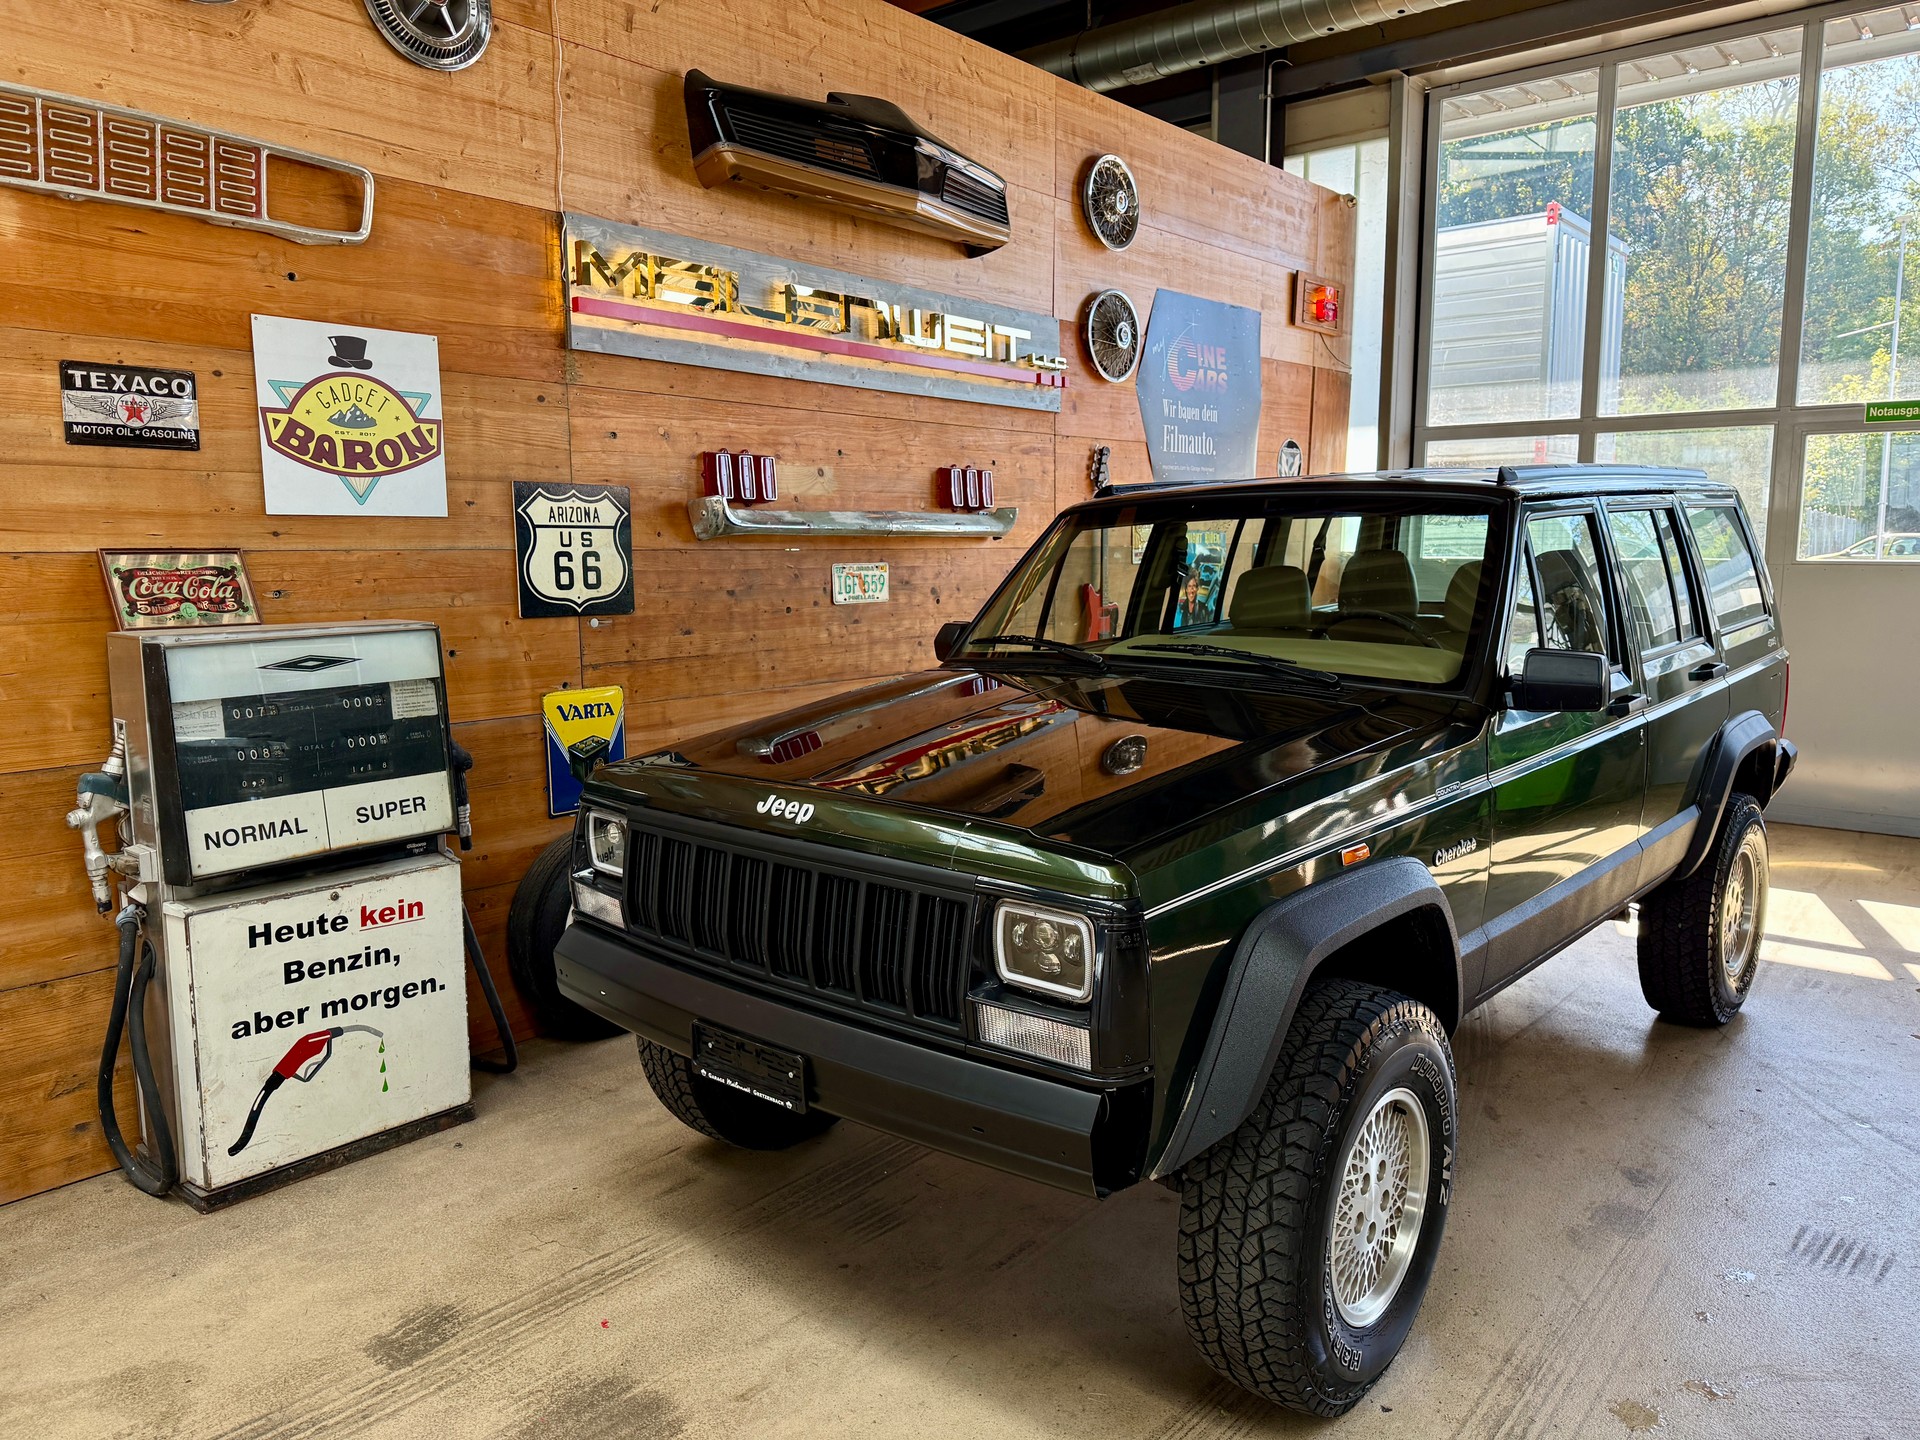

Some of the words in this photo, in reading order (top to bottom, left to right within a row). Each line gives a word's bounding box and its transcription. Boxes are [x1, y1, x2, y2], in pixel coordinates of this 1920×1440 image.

[67, 369, 190, 396] TEXACO
[315, 382, 390, 413] GADGET
[1162, 398, 1177, 418] Wir
[1178, 400, 1200, 423] bauen
[1201, 403, 1218, 424] dein
[1869, 406, 1920, 418] Notausga
[72, 424, 114, 436] MOTOR
[116, 426, 134, 437] OIL
[141, 428, 196, 441] GASOLINE
[274, 416, 436, 471] BARON
[1162, 424, 1217, 456] Filmauto.
[548, 506, 601, 523] ARIZONA
[553, 550, 602, 591] 66
[128, 575, 234, 601] Coca-Cola
[556, 702, 615, 722] VARTA
[355, 796, 427, 824] SUPER
[756, 794, 815, 825] Jeep
[204, 817, 308, 850] NORMAL
[1435, 837, 1477, 867] Cherokee
[248, 912, 349, 949] Heute
[359, 898, 425, 931] kein
[283, 945, 400, 985] Benzin,
[231, 1005, 310, 1040] aber
[321, 976, 446, 1019] morgen.
[1410, 1052, 1452, 1136] Dynapro
[1323, 1236, 1363, 1372] Hankook
